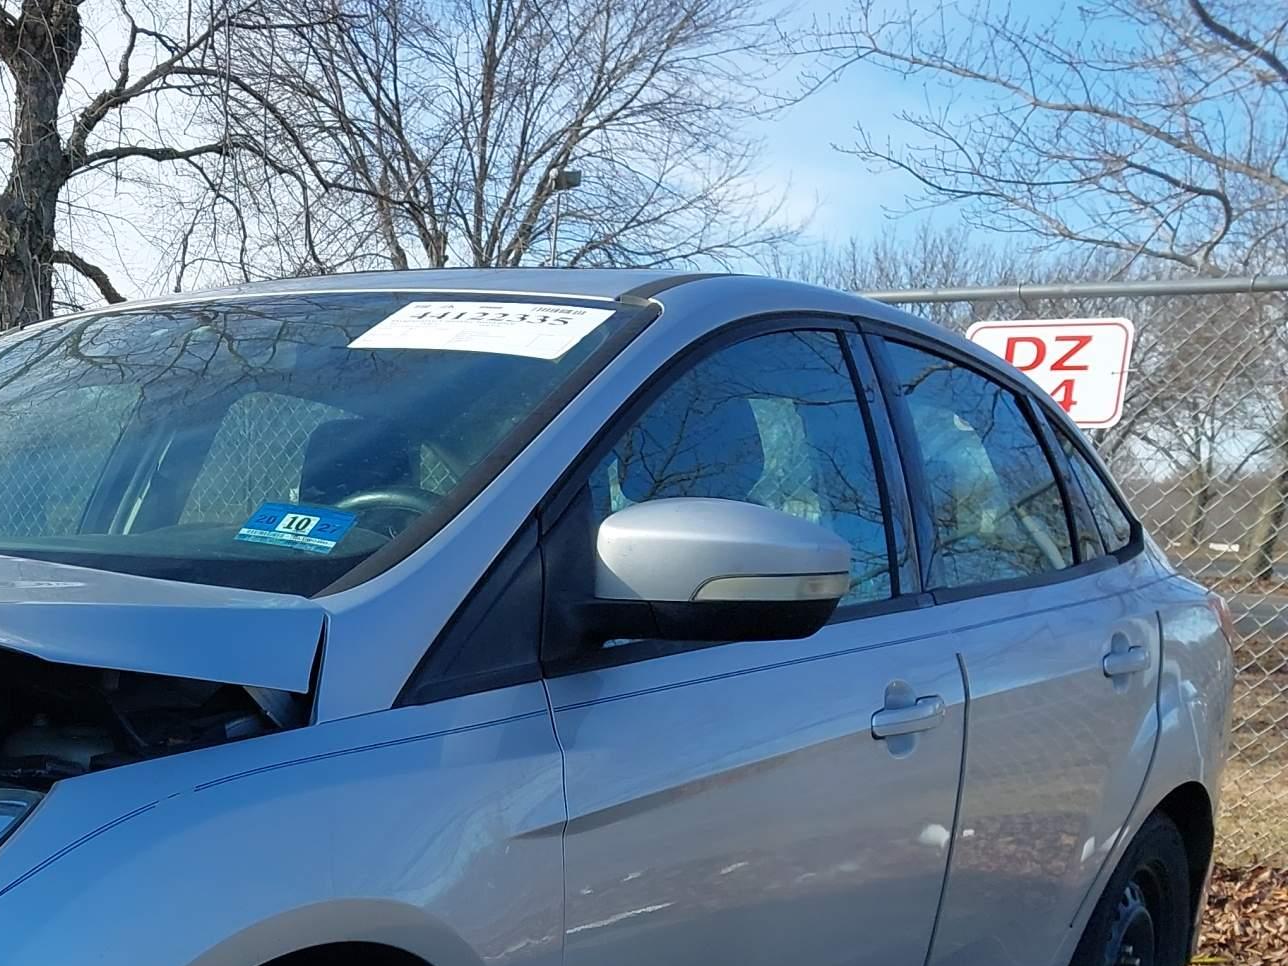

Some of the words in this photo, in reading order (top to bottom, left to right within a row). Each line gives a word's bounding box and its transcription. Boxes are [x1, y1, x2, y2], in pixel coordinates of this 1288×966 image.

[411, 311, 570, 326] 44122335
[1004, 335, 1093, 371] DZ
[1050, 379, 1078, 413] 4
[283, 516, 312, 531] 10
